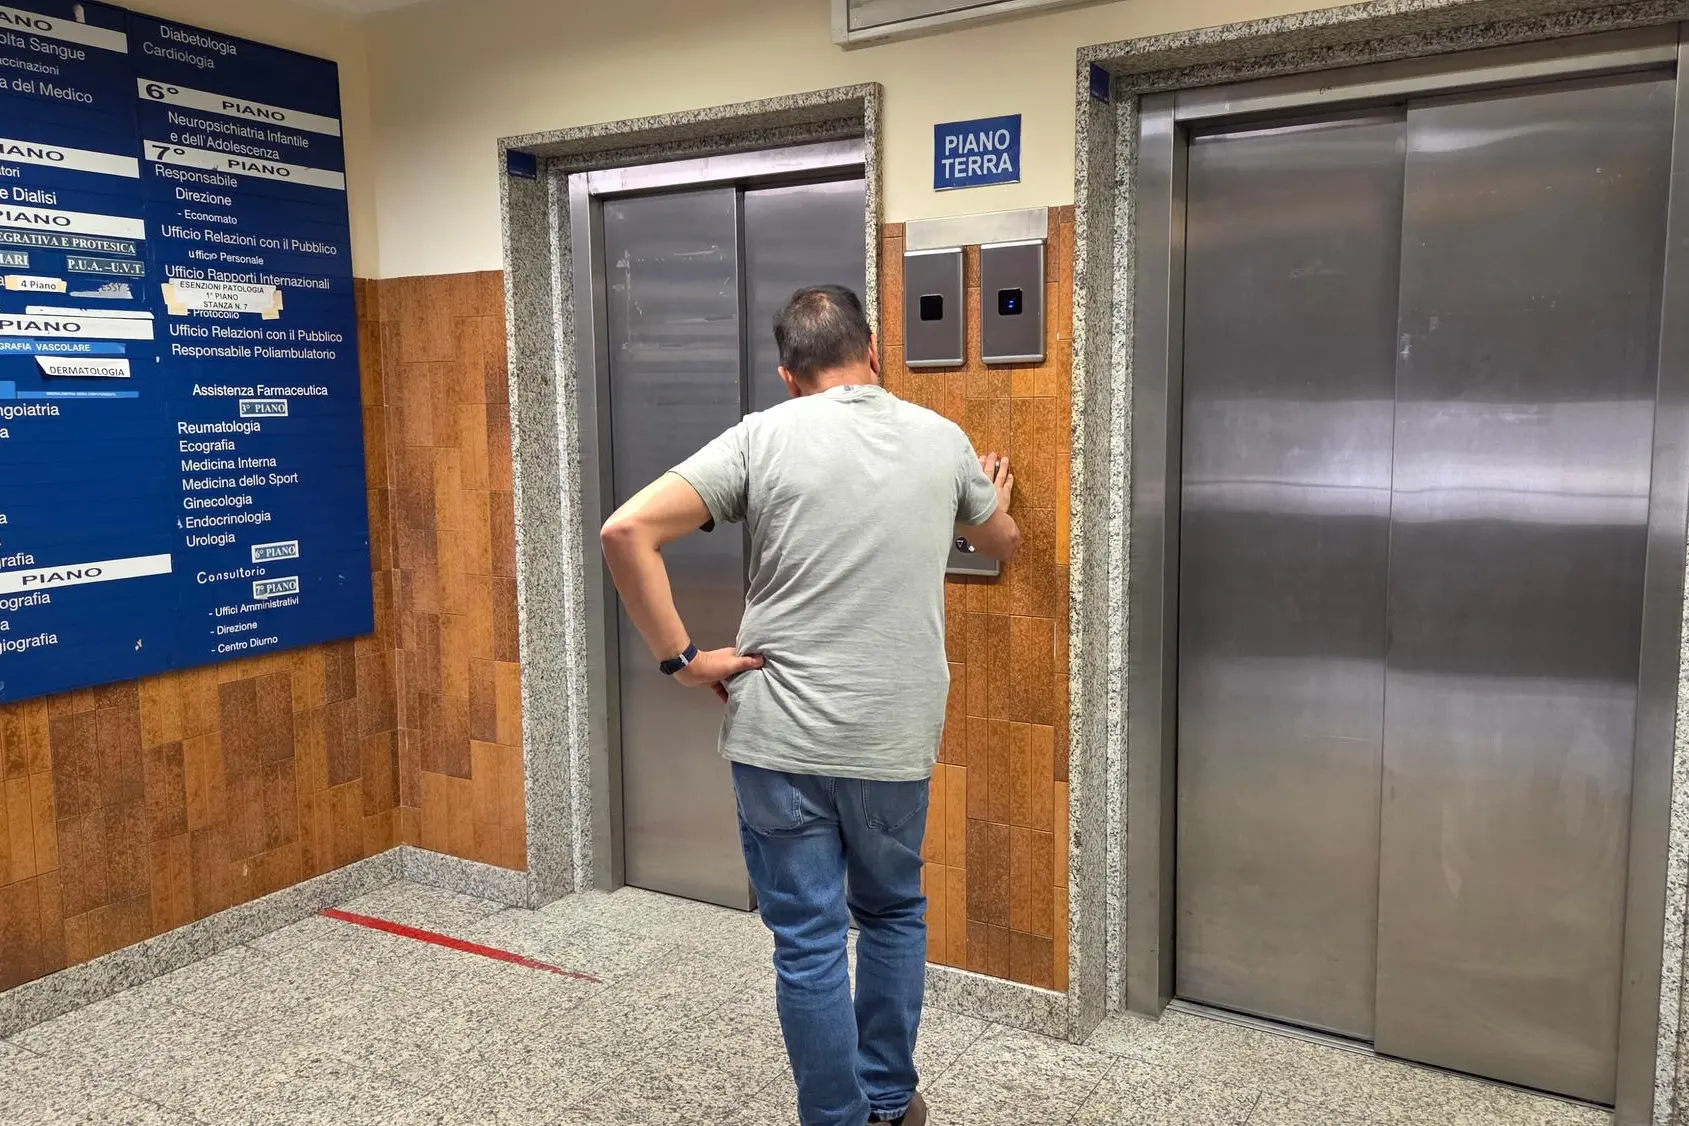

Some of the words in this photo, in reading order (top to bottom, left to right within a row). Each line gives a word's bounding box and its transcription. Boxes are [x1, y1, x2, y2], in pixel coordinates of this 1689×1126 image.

[30, 37, 86, 60] Sangue
[160, 25, 238, 56] Diabetologia
[143, 41, 215, 69] Cardiologia
[12, 78, 35, 93] del
[40, 82, 93, 104] Medico
[222, 101, 286, 122] PIANO
[168, 111, 265, 140] Neuropsichiatria
[267, 129, 309, 148] Infantile
[170, 132, 178, 142] e
[182, 134, 280, 160] dell'Adolescenza
[945, 129, 1010, 156] PIANO
[228, 159, 291, 177] PIANO
[941, 152, 1013, 179] TERRA
[155, 164, 238, 188] Responsabile
[13, 187, 57, 205] Dialisi
[175, 187, 232, 206] Direzione
[184, 209, 238, 225] Economato
[61, 238, 69, 247] E
[72, 239, 136, 254] PROTESICA
[161, 224, 201, 240] Ufficio
[205, 229, 257, 247] Relazioni
[259, 238, 280, 249] con
[283, 239, 289, 250] il
[291, 240, 337, 255] Pubblico
[220, 252, 264, 265] Personale
[21, 280, 27, 288] 4
[30, 281, 57, 290] Piano
[165, 264, 204, 279] Ufficio
[207, 268, 257, 284] Rapporti
[260, 274, 330, 290] Internazionali
[180, 281, 221, 291] ESENZIONI
[223, 284, 264, 294] PATOLOGIA
[203, 300, 233, 309] STANZA
[214, 292, 239, 301] PIANO
[0, 320, 81, 332] PIANO
[169, 323, 209, 337] Ufficio
[212, 326, 263, 340] Relazioni
[265, 330, 287, 341] con
[289, 329, 295, 341] il
[297, 330, 343, 343] Pubblico
[36, 343, 91, 352] VASCOLARE
[172, 343, 251, 358] Responsabile
[254, 344, 336, 360] Poliambulatorio
[49, 366, 125, 376] DERMATOLOGIA
[192, 383, 254, 396] Assistenza
[257, 384, 328, 396] Farmaceutica
[255, 403, 285, 413] PIANO
[178, 420, 261, 435] Reumatologia
[179, 439, 235, 453] Ecografia
[181, 458, 235, 471] Medicina
[238, 457, 277, 469] Interna
[182, 477, 236, 490] Medicina
[239, 474, 266, 487] dello
[268, 472, 298, 487] Sport
[183, 494, 253, 509] Ginecologia
[185, 510, 271, 528] Endocrinologia
[186, 532, 236, 547] Urologia
[266, 545, 296, 557] PIANO
[22, 567, 103, 586] PIANO
[197, 567, 266, 584] Consultorio
[266, 581, 297, 593] PIANO
[215, 605, 238, 617] Uffici
[240, 596, 299, 613] Amministrativi
[217, 621, 258, 635] Direzione
[217, 641, 248, 653] Centro
[250, 635, 279, 648] Diurno
